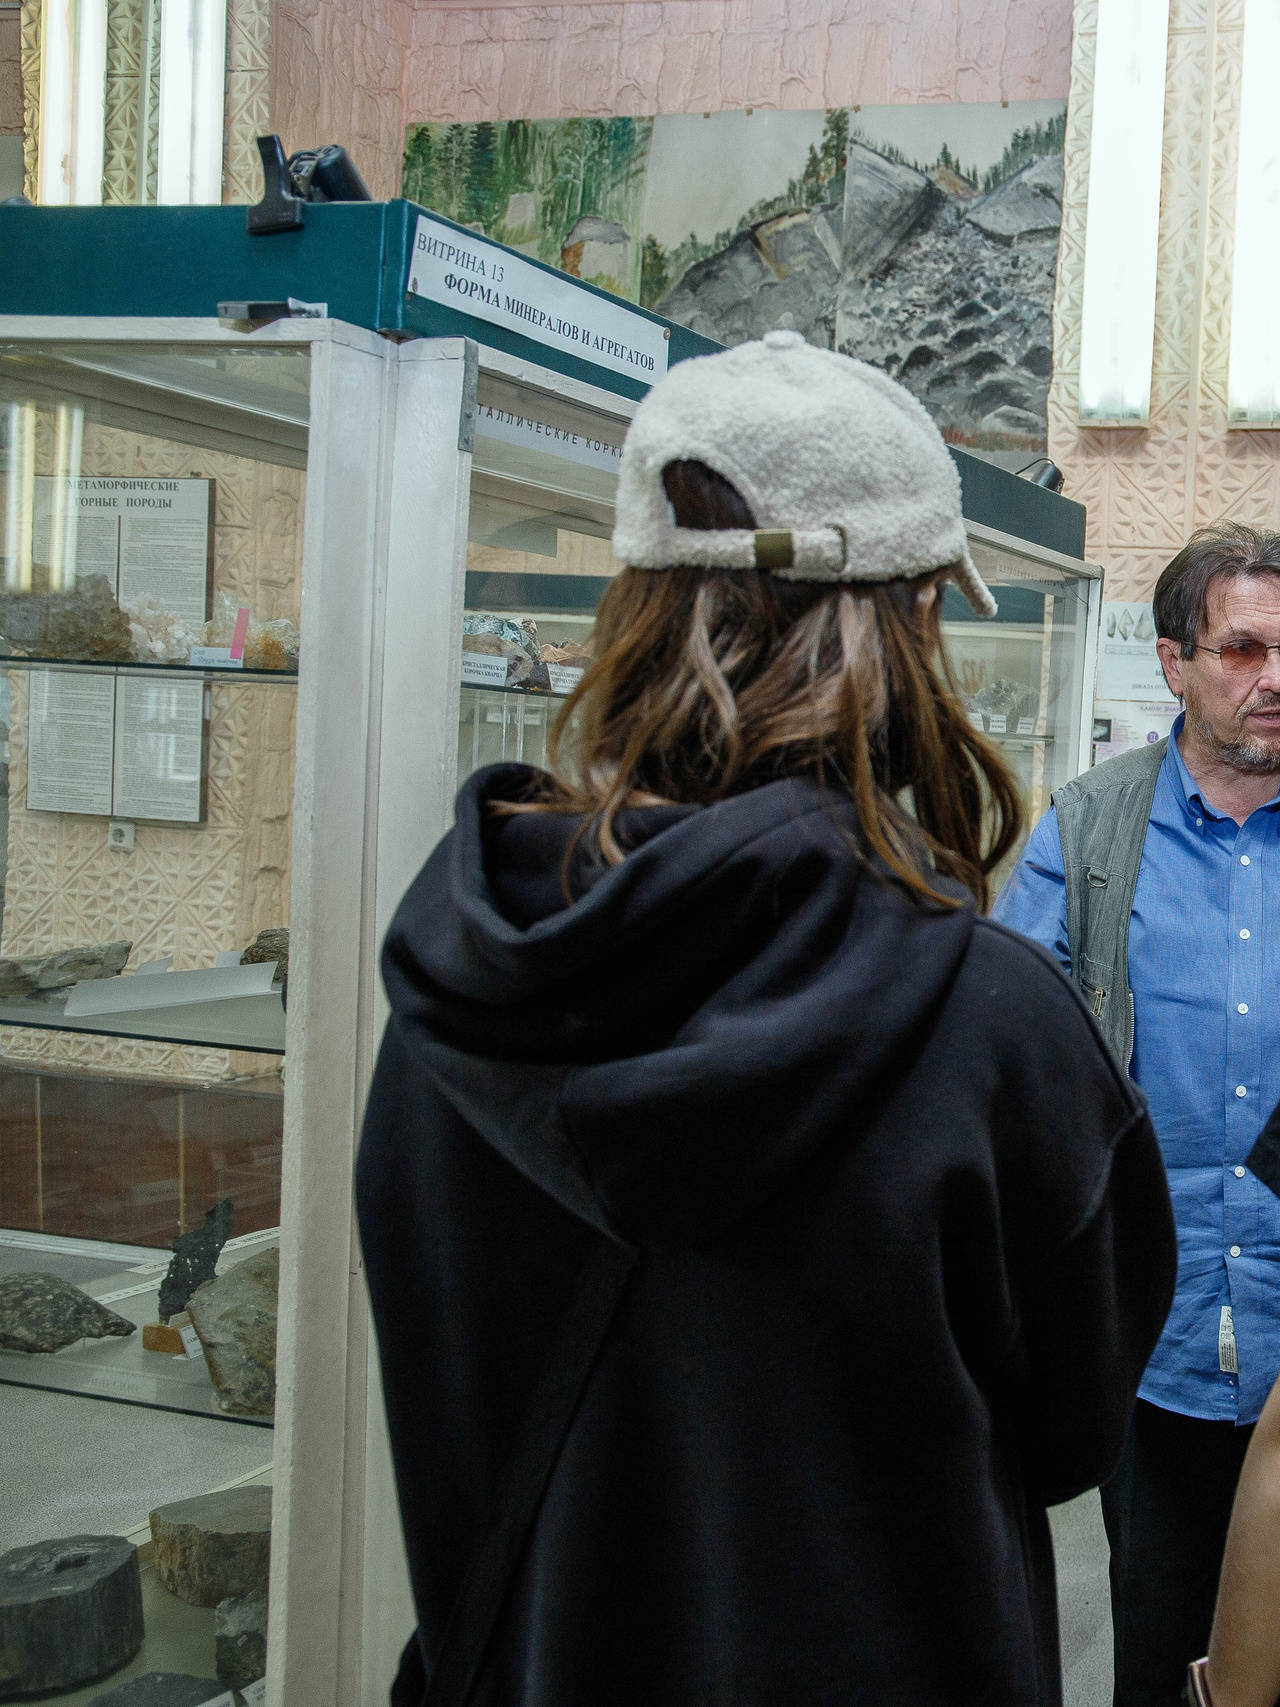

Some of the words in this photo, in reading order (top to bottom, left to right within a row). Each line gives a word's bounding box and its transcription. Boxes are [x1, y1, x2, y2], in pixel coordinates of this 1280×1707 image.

[417, 232, 488, 278] ВИТРИНА
[491, 263, 505, 284] 13
[444, 273, 502, 308] ФОРМА
[504, 295, 580, 341] МИНЕРАЛОВ
[581, 328, 591, 344] И
[592, 335, 656, 371] АГРЕГАТОВ
[477, 403, 579, 445] ТАЛЛИЧЕСКИЕ
[68, 480, 180, 491] МЕТАМОРФИЧЕСКИЕ
[75, 497, 119, 507] ГОРНЫЕ
[126, 497, 172, 509] ПОРОДЫ
